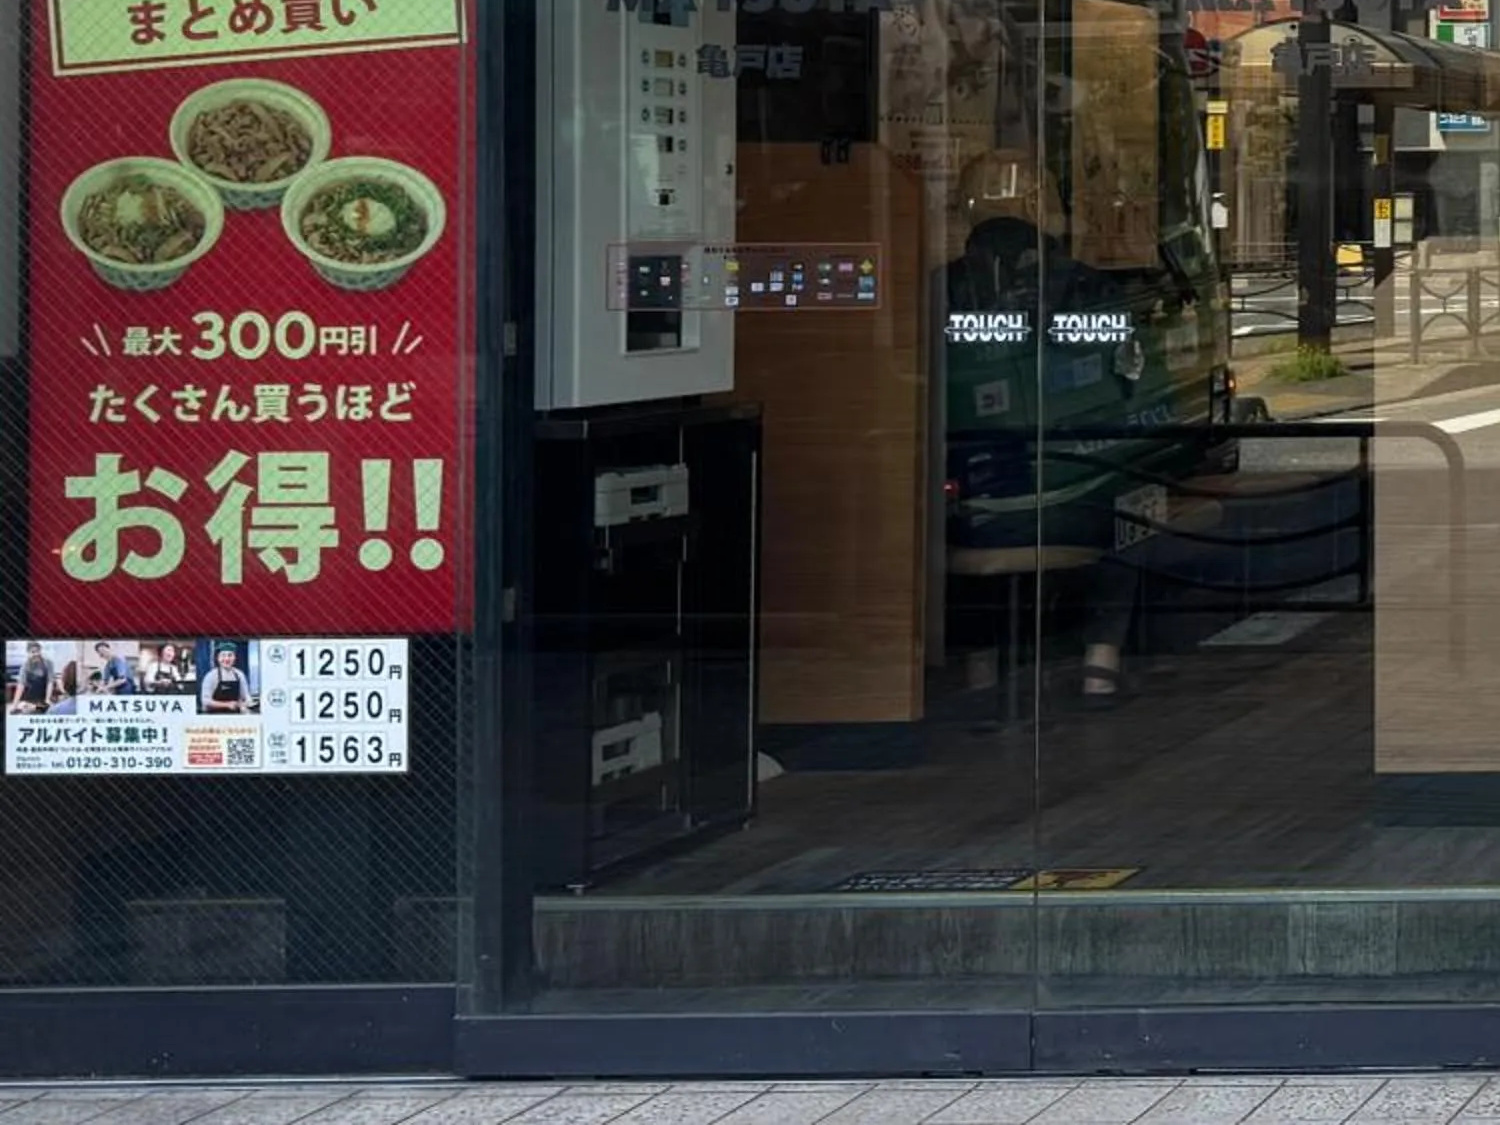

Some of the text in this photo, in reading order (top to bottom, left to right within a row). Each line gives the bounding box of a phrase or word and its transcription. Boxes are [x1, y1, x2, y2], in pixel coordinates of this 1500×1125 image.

[697, 44, 804, 79] 亀戸店
[950, 314, 1126, 342] TOUCH TOUCH
[88, 382, 417, 424] たくさん買うほど
[61, 450, 446, 586] お得!!
[89, 700, 184, 713] MATSUYA
[18, 726, 169, 744] アルバイト募集中!
[66, 756, 173, 769] 0120-310-390
